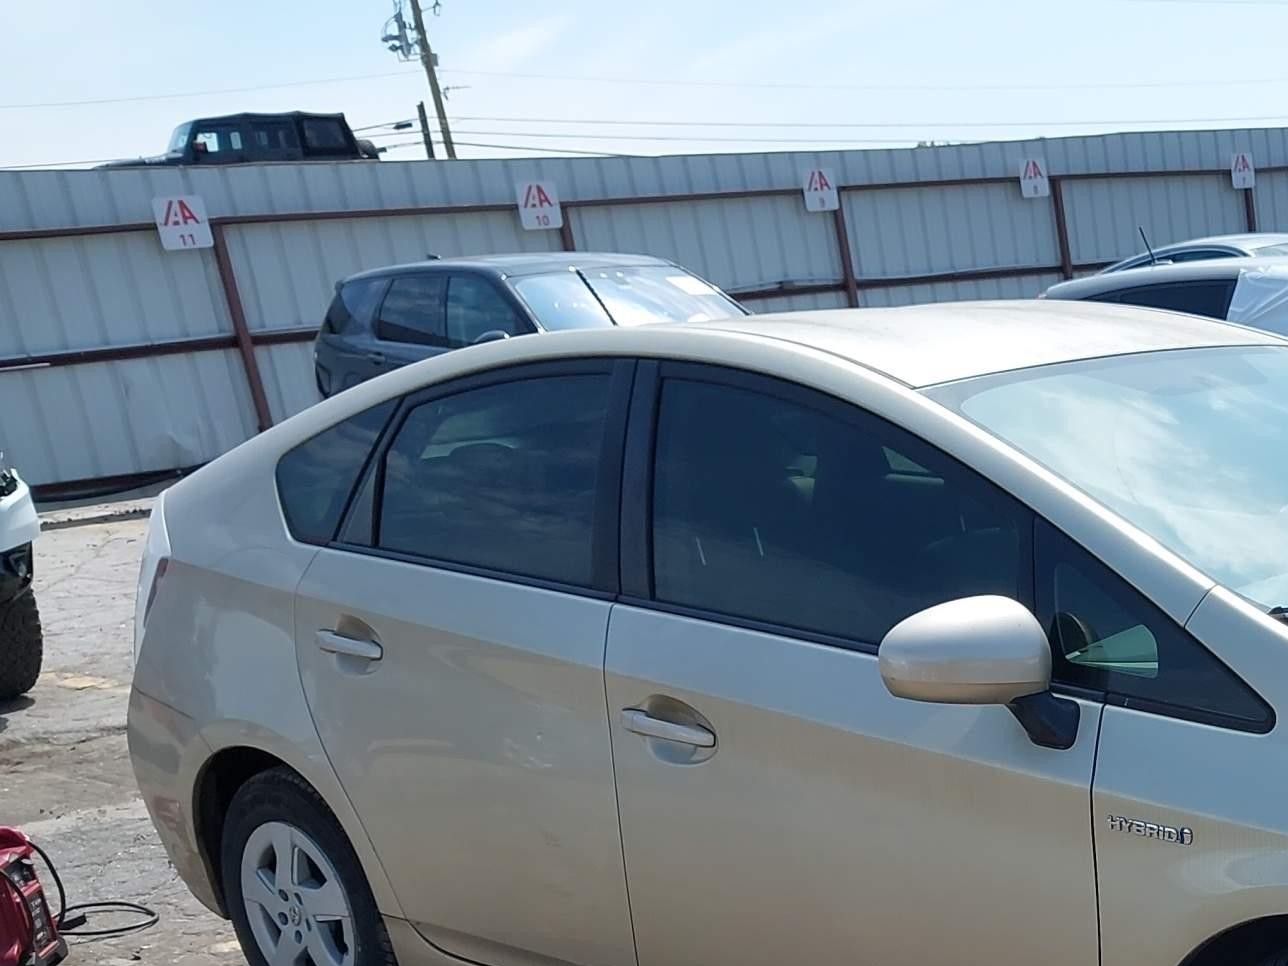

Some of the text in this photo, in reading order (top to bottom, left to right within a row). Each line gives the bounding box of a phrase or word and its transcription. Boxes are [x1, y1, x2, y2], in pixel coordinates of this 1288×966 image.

[536, 215, 550, 226] 10
[179, 234, 196, 247] 11
[1107, 814, 1180, 843] HYBRID
